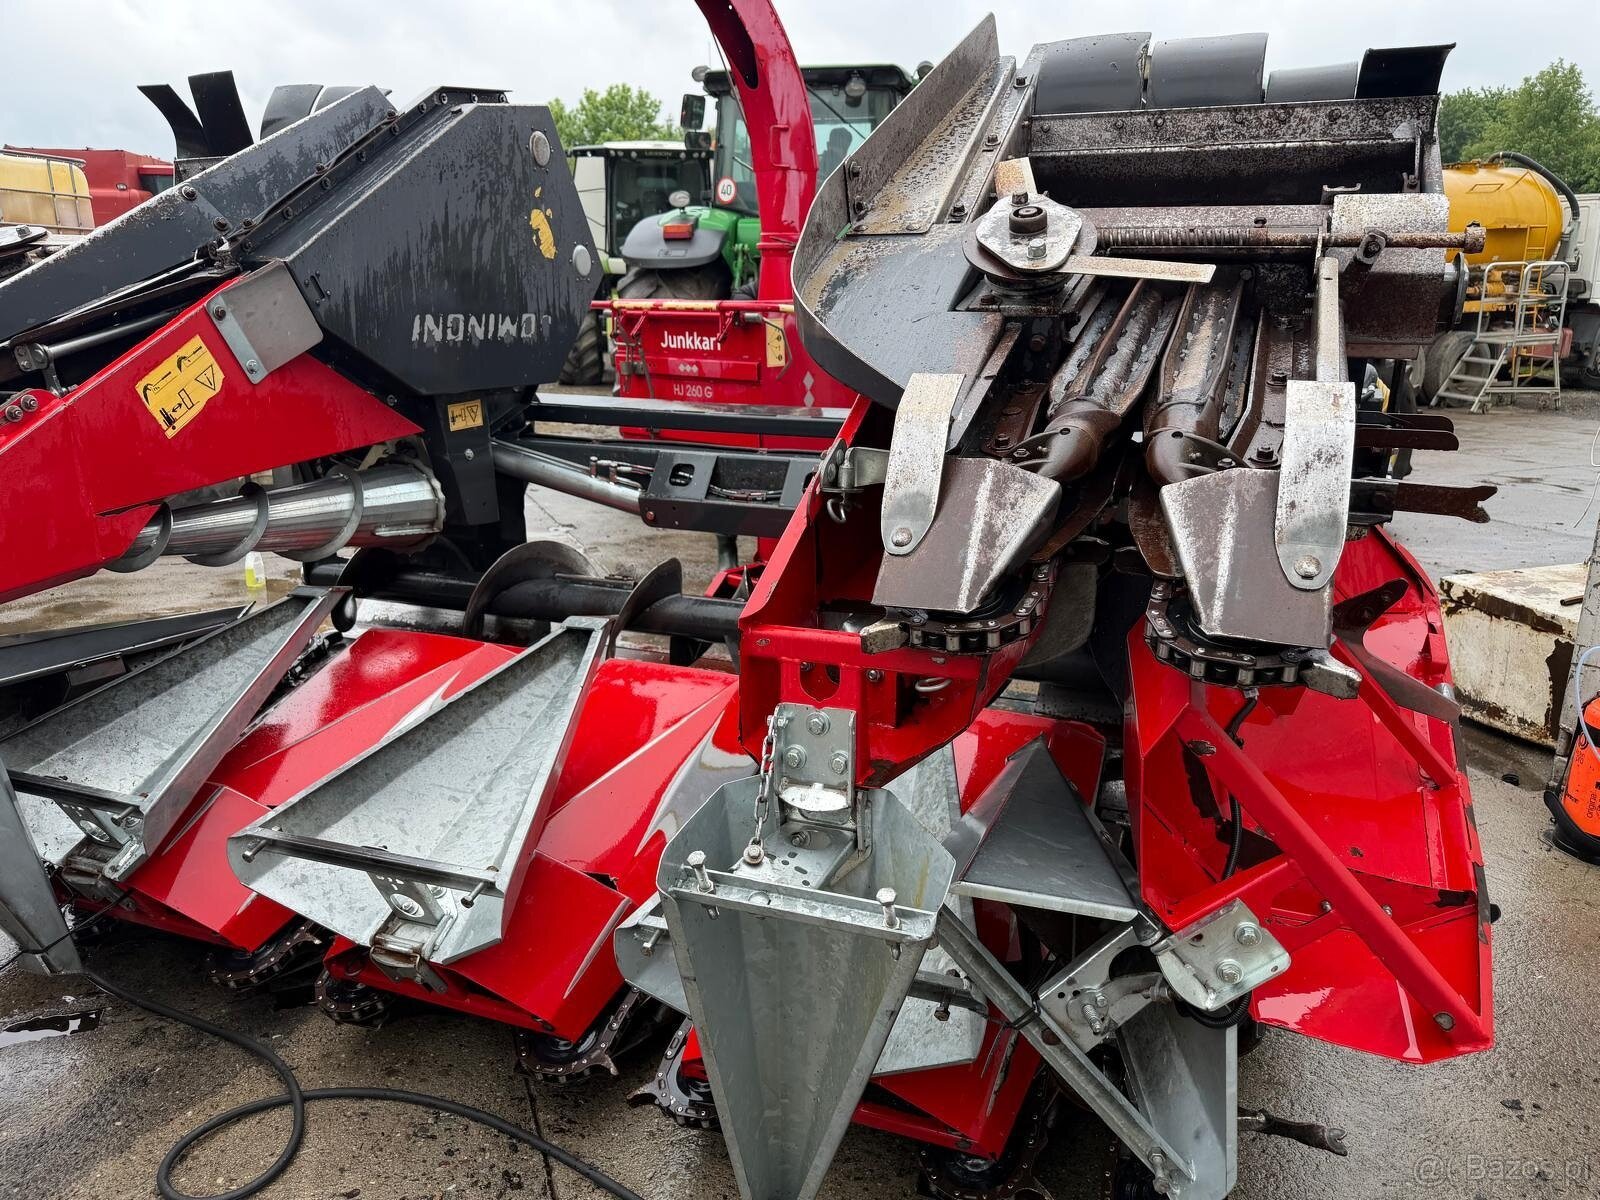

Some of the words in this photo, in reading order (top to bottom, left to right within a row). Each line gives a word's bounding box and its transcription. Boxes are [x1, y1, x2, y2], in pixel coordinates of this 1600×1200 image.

[720, 184, 732, 195] 40
[673, 383, 684, 396] HJ
[685, 384, 703, 398] 260
[704, 386, 713, 399] G
